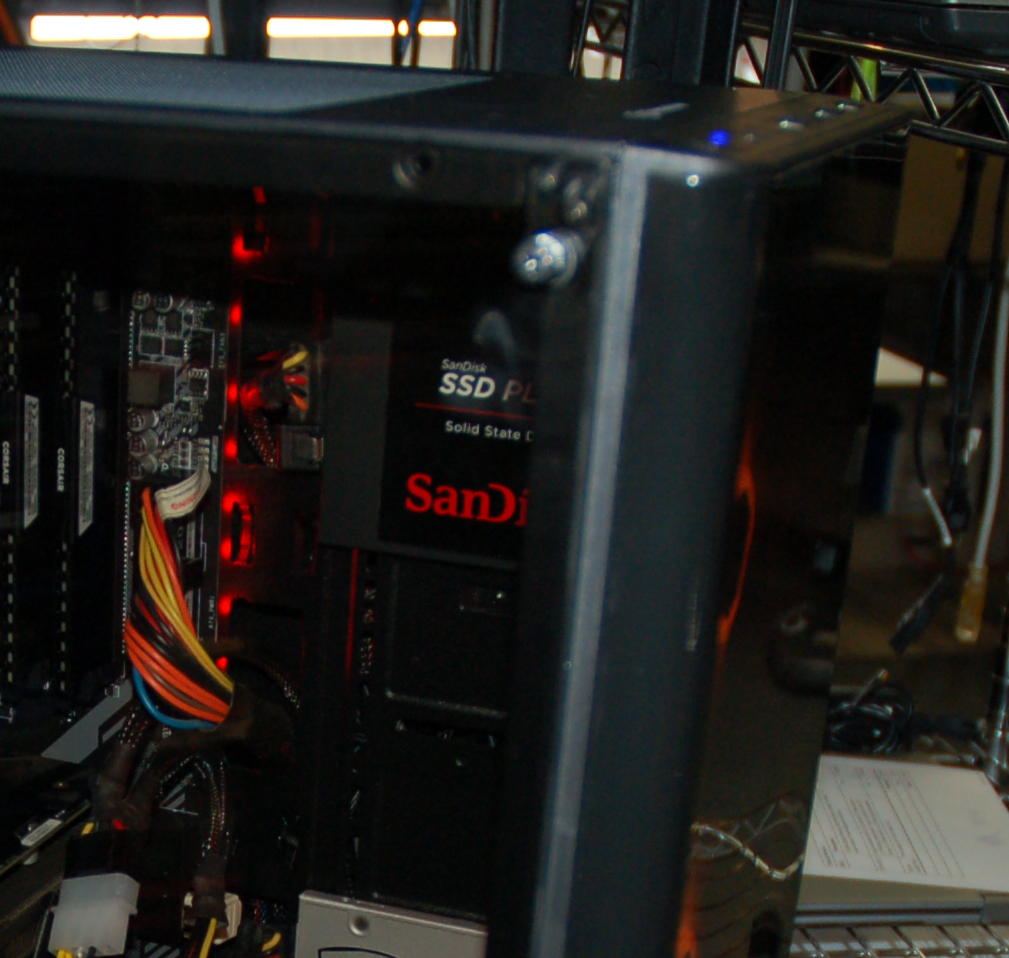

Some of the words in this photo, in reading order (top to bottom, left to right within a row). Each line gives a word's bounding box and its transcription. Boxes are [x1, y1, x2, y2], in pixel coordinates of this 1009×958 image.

[441, 358, 487, 373] SanDisk
[438, 372, 495, 399] SSD
[445, 420, 480, 436] Solid
[484, 425, 521, 441] State
[2, 441, 11, 485] CORSAIR
[57, 447, 66, 492] CORSAIR
